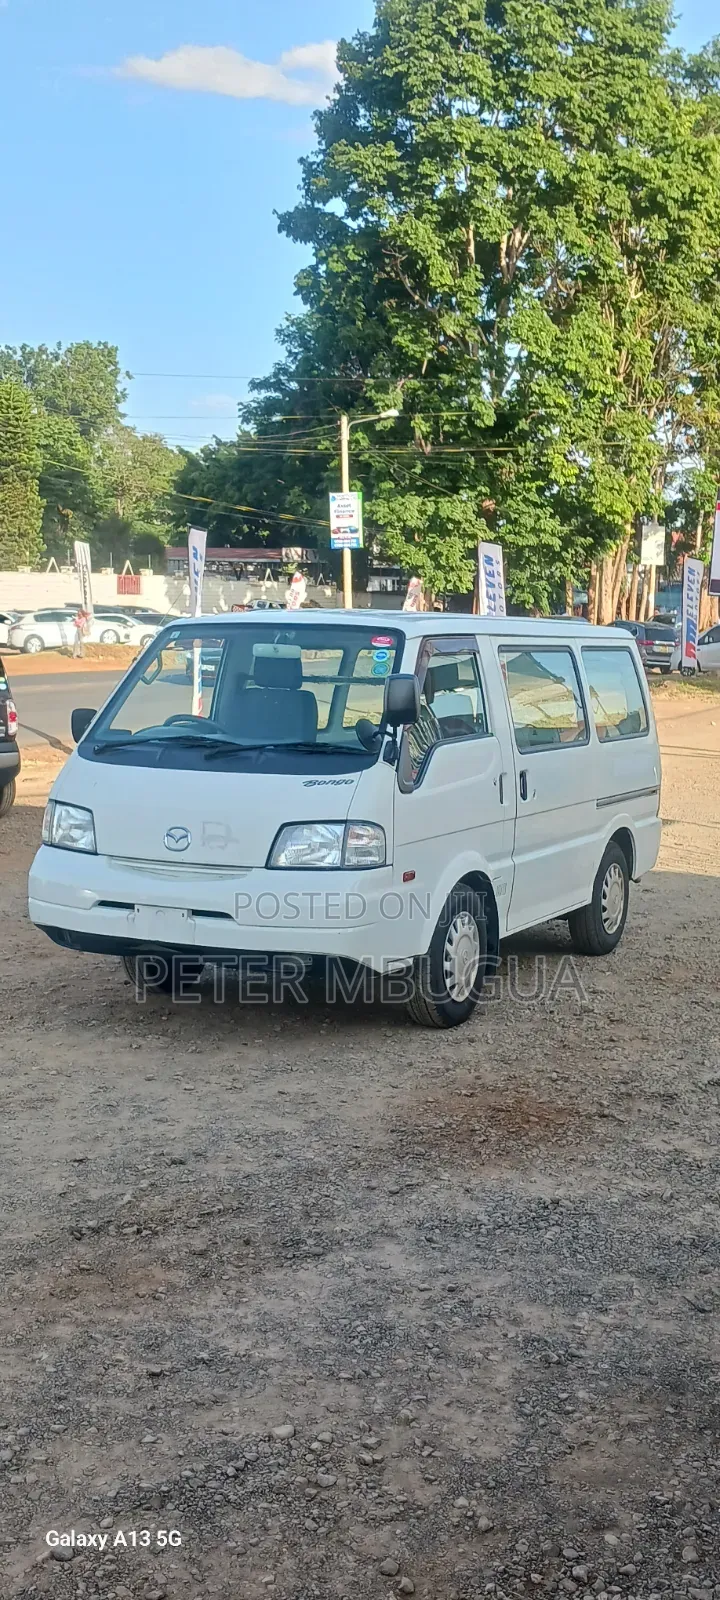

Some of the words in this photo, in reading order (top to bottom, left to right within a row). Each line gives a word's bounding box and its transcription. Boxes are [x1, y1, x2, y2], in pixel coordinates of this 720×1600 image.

[484, 554, 497, 616] LEVEN
[495, 560, 505, 613] OTORS
[686, 566, 697, 618] ELEVEN
[302, 778, 355, 788] Bongo
